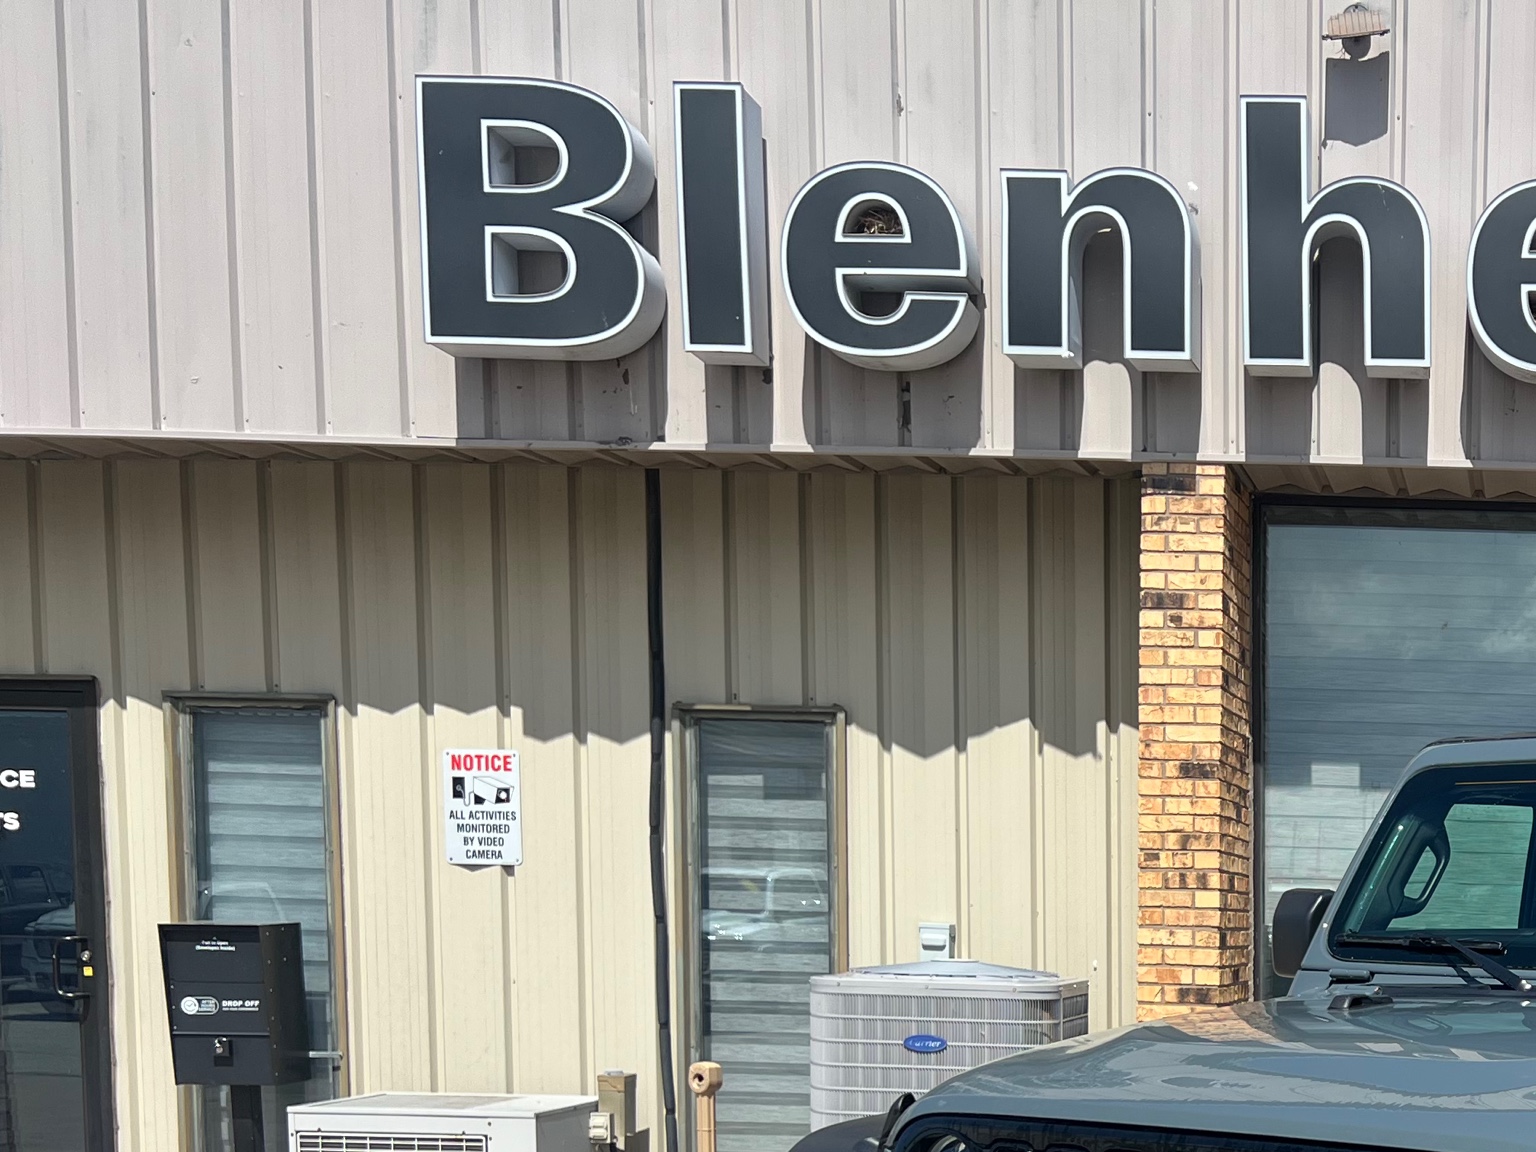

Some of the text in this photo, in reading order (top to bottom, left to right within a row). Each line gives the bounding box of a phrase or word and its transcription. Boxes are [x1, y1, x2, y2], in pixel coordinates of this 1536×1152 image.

[451, 754, 512, 772] NOTICE
[449, 810, 517, 821] ALL ACTIVITIES
[456, 823, 510, 834] MONITORED
[463, 836, 505, 847] BY VIDEO
[465, 849, 503, 860] CAMERA
